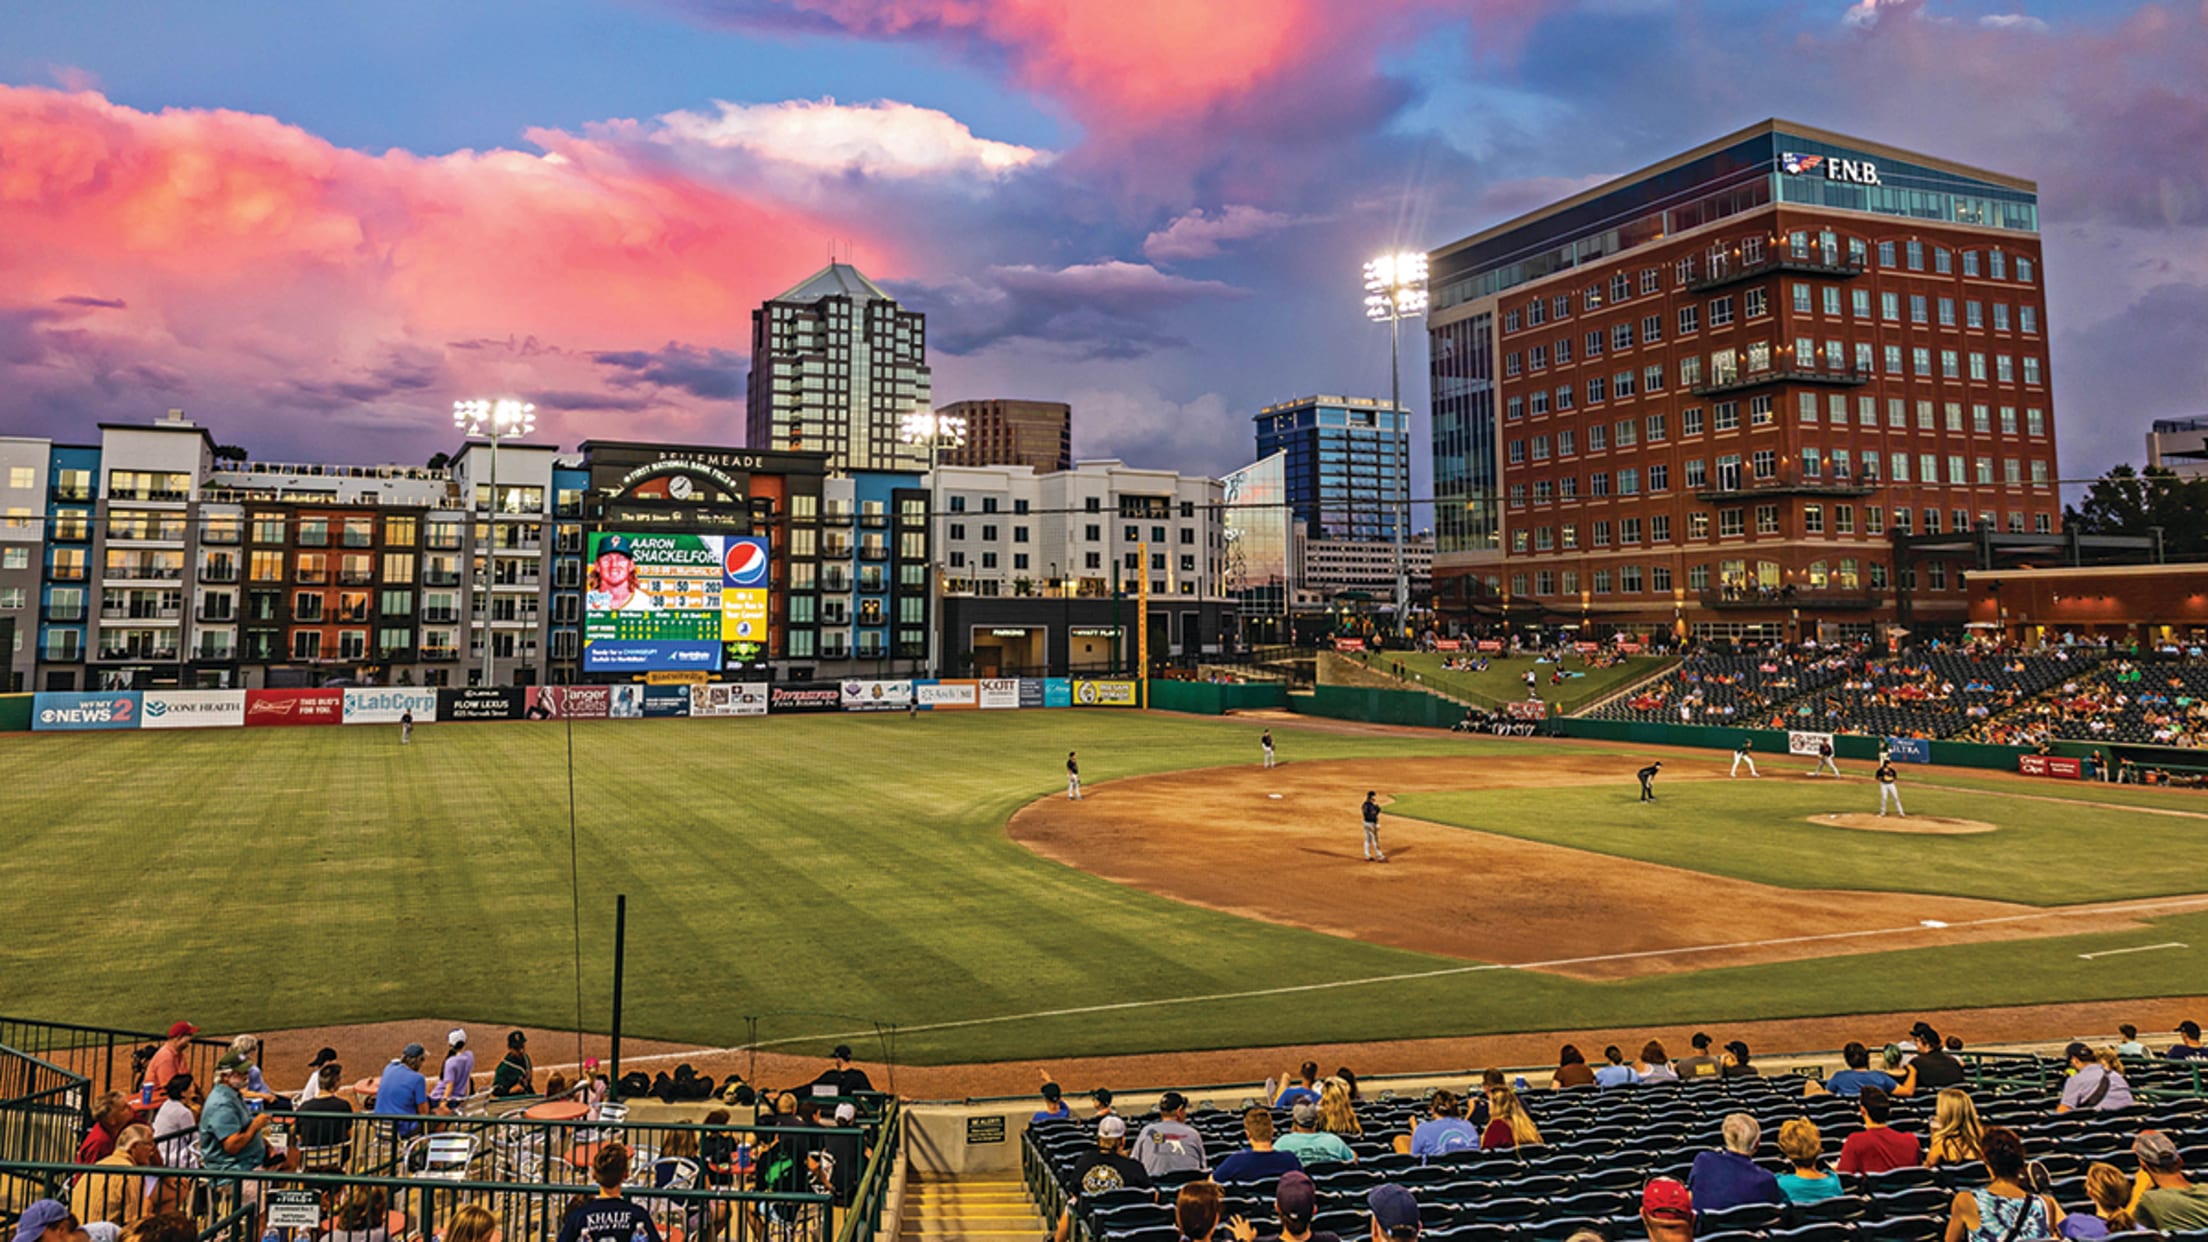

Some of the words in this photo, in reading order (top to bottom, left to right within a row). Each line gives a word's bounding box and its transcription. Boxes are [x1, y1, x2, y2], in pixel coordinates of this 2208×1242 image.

[1828, 157, 1881, 186] F.N.B.
[651, 460, 689, 471] NATIONAL
[630, 538, 676, 549] AARON
[993, 629, 1026, 637] PARKING
[981, 680, 1015, 692] SCOTT
[562, 688, 608, 702] Tanger
[79, 700, 112, 710] WFMY
[167, 702, 196, 713] CONE
[199, 702, 241, 713] HEALTH
[357, 693, 434, 712] LabCorp
[454, 700, 479, 709] FLOW
[481, 700, 509, 709] LEXUS
[55, 709, 112, 722] NEWS
[112, 698, 134, 722] 2
